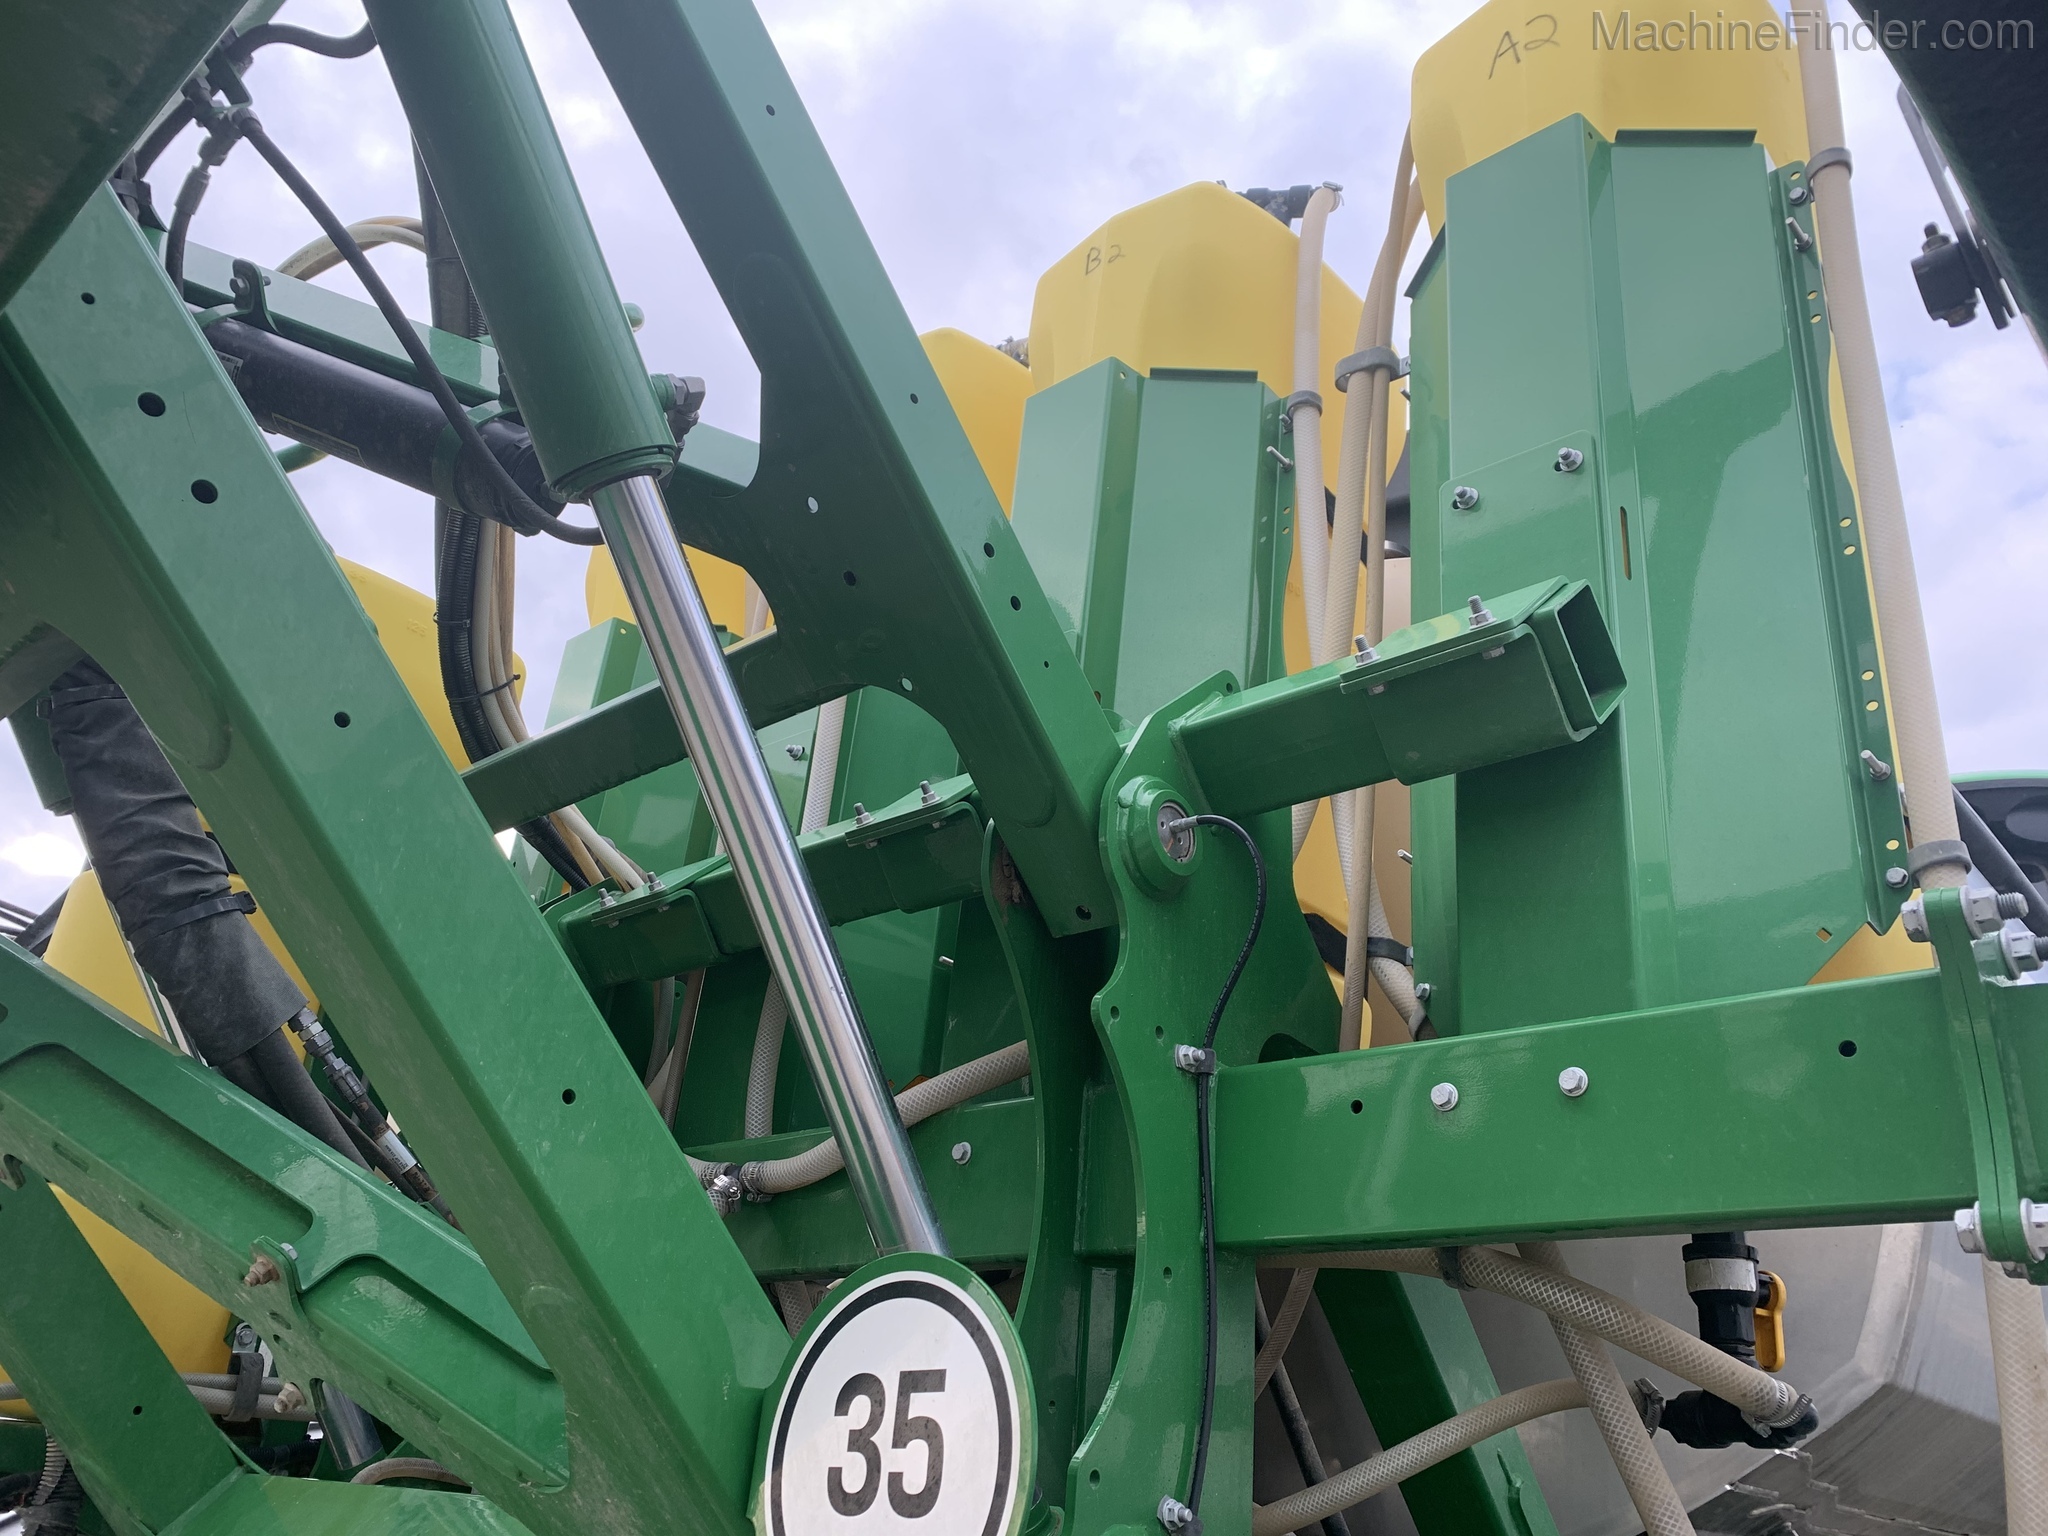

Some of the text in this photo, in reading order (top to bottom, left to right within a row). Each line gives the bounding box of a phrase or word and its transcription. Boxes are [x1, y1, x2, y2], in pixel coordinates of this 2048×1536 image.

[1488, 13, 1561, 80] A2
[1085, 244, 1127, 276] B2
[826, 1368, 948, 1520] 35
